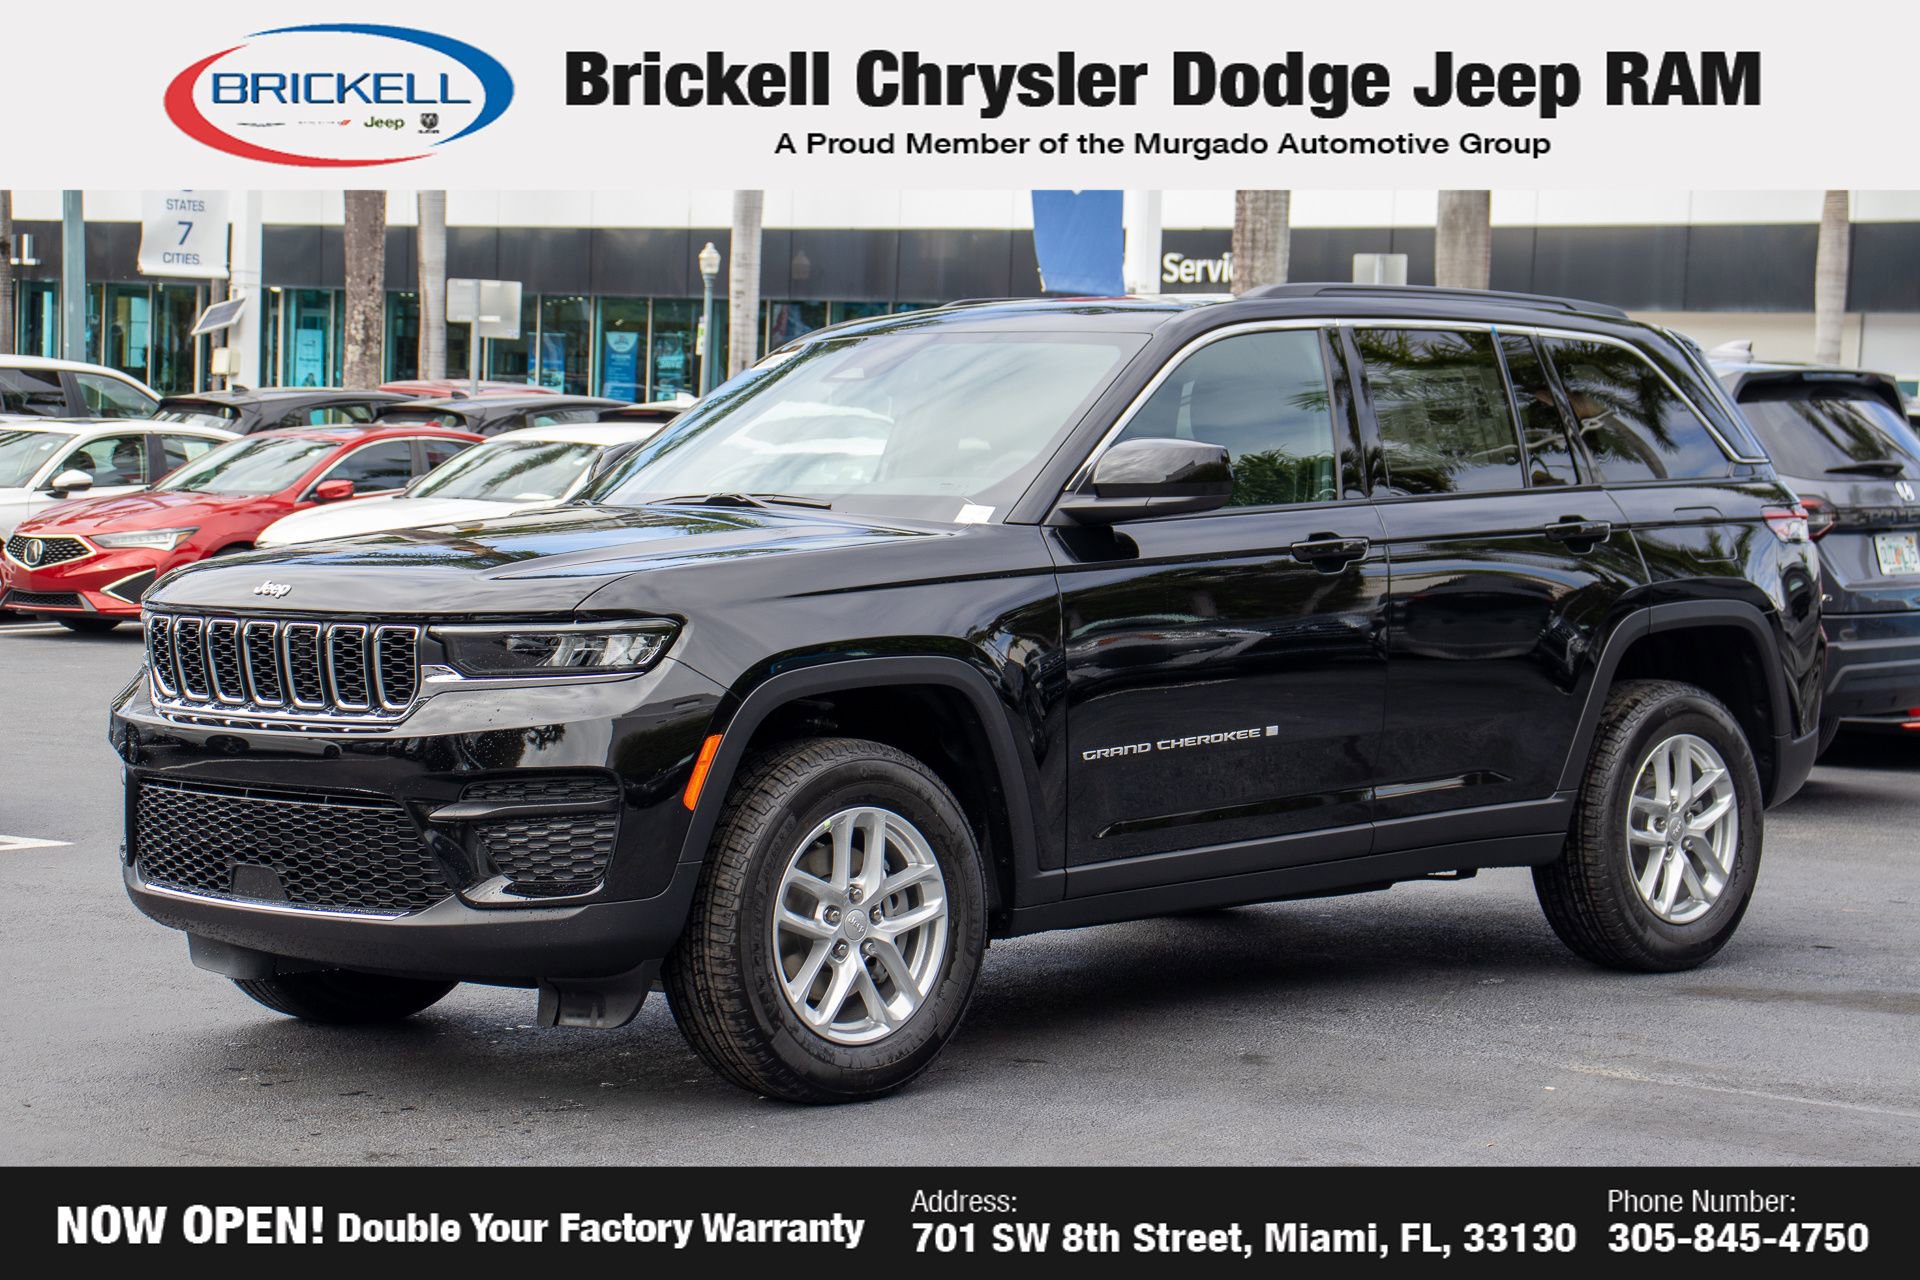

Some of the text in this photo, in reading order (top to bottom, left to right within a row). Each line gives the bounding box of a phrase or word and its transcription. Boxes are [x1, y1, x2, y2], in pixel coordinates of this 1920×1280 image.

[177, 220, 193, 245] 7
[253, 579, 293, 599] Jeep
[1082, 728, 1261, 761] GRAND CHEROKEE
